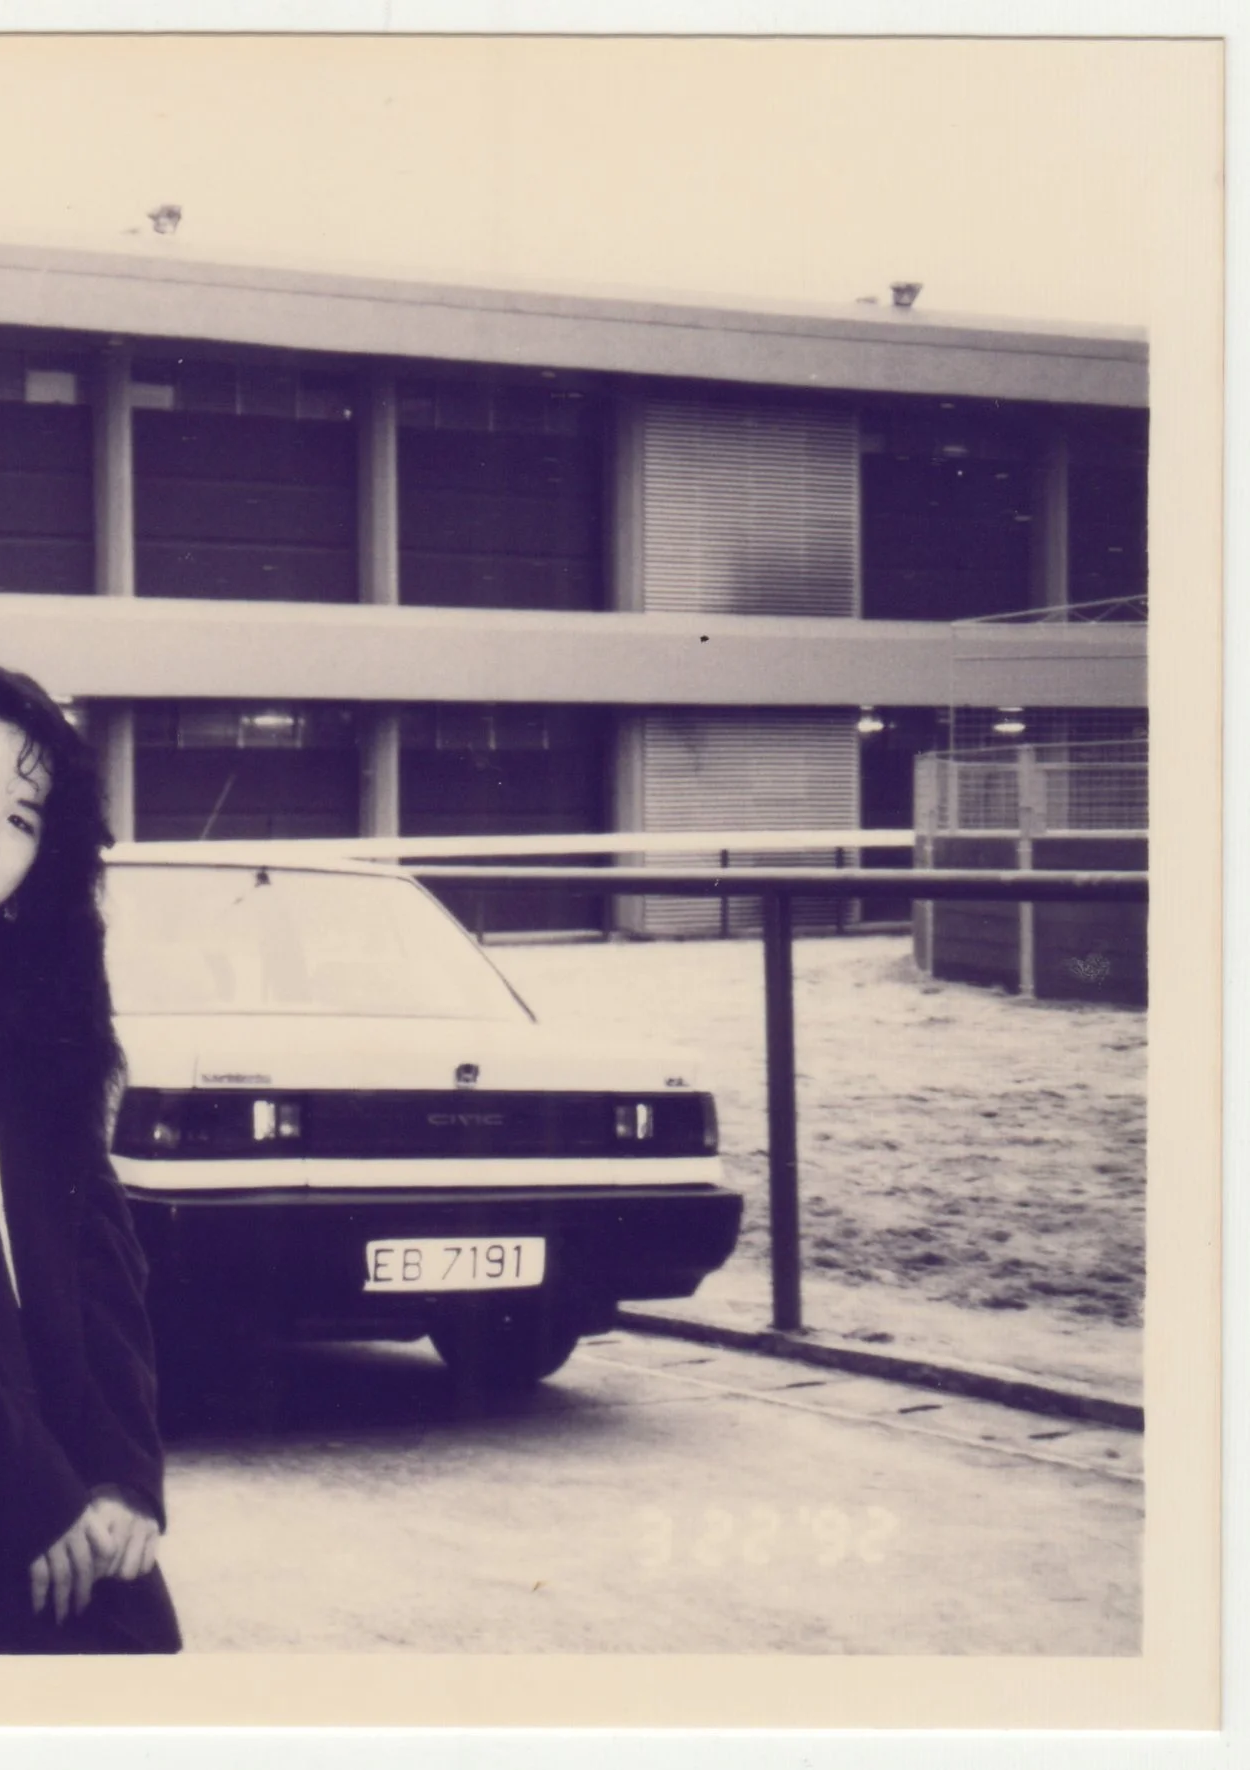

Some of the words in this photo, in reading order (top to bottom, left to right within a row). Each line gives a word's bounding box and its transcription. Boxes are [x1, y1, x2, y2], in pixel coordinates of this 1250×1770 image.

[428, 1112, 505, 1127] CIVIC
[372, 1248, 423, 1283] EB
[440, 1244, 523, 1280] 7191
